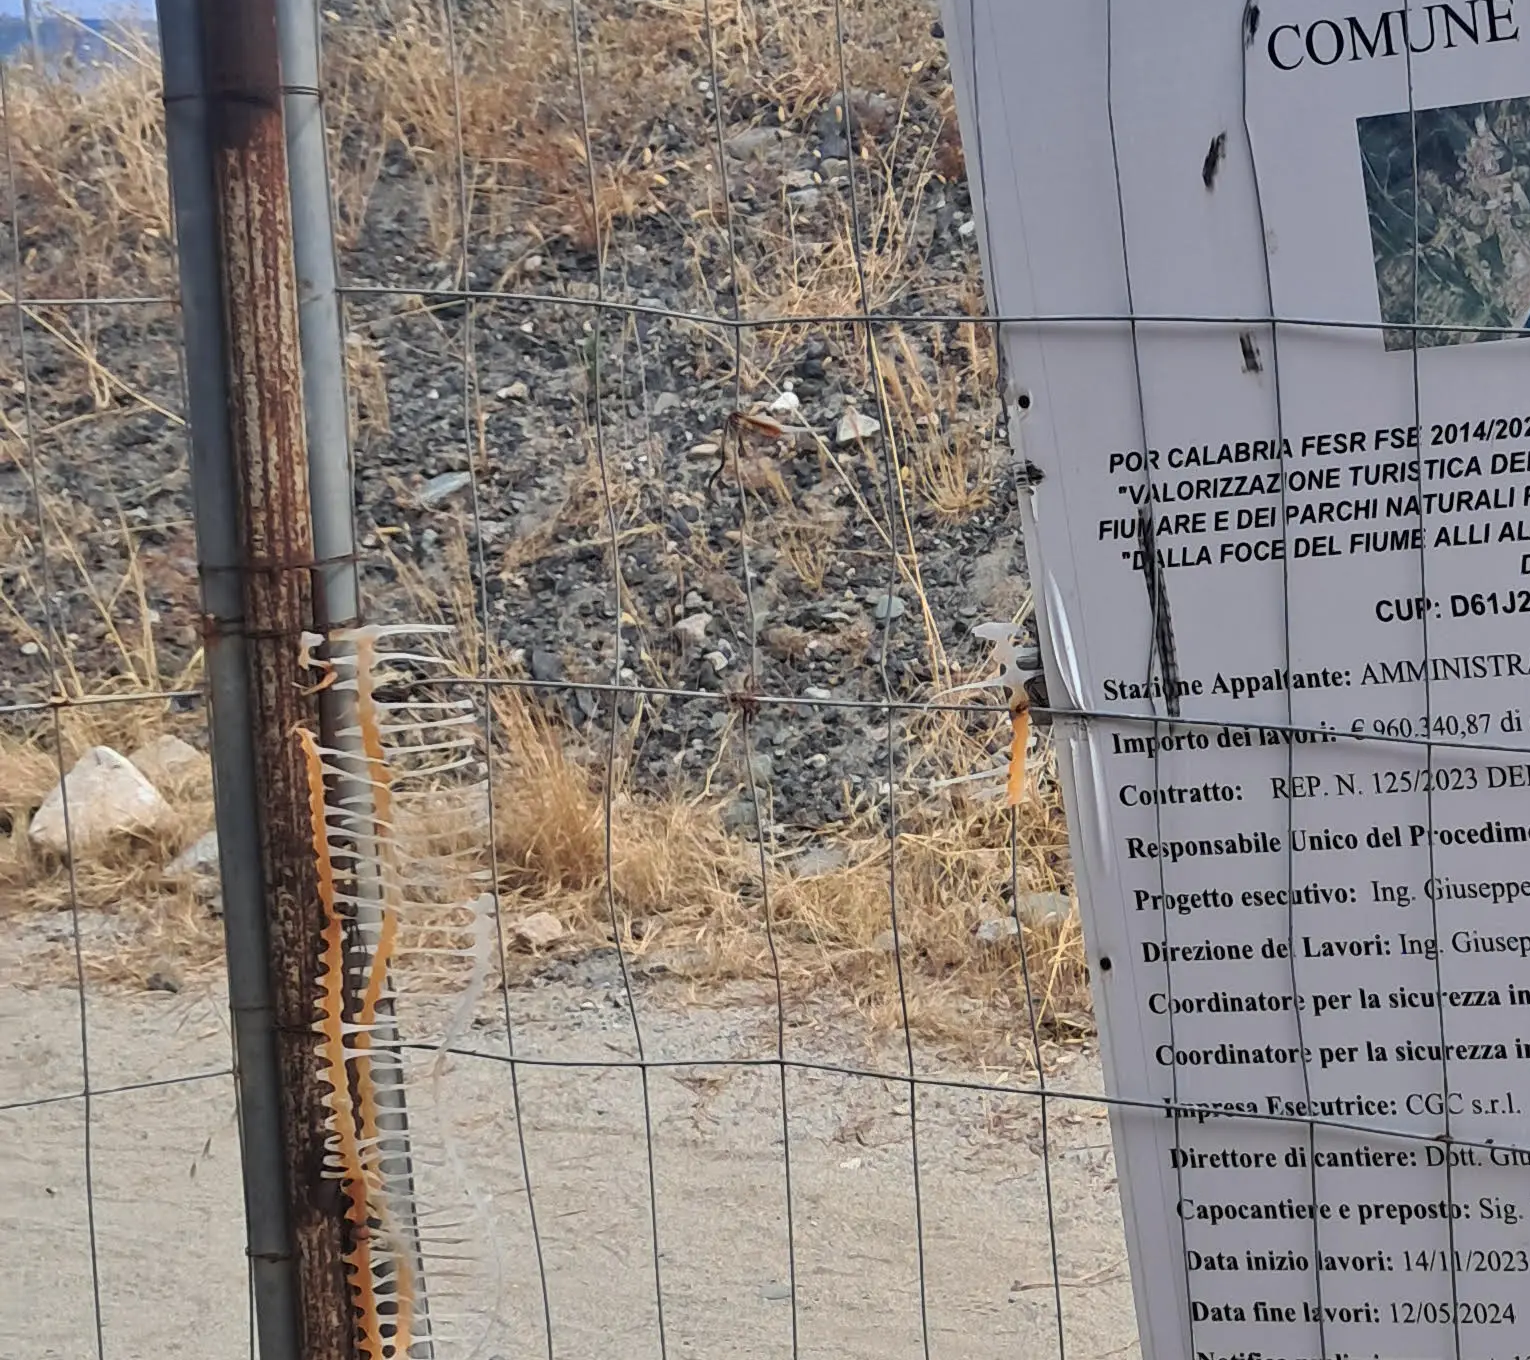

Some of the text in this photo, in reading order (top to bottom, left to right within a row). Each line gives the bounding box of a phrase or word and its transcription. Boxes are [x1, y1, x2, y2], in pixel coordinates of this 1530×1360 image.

[1109, 450, 1158, 473] POR
[1167, 439, 1293, 468] CALABRIA
[1302, 432, 1366, 456] FESR
[1375, 426, 1424, 450] FSE
[1349, 455, 1482, 487] TURISTICA
[1099, 511, 1206, 540] FIUMARE
[1214, 510, 1229, 532] E
[1237, 507, 1276, 530] DEI
[1285, 497, 1377, 526] PARCHI
[1385, 487, 1515, 517] NATURALI
[1220, 540, 1285, 563] FOCE
[1294, 536, 1341, 559] DEL
[1349, 529, 1426, 554] FIUME
[1434, 522, 1490, 548] ALLI
[1375, 596, 1442, 623] CUP:
[1104, 676, 1203, 701] Stazine
[1211, 667, 1351, 698] Appaltante:
[1113, 731, 1209, 758] Importo
[1217, 726, 1251, 748] dei
[1372, 714, 1491, 739] 960.340,87
[1501, 709, 1522, 733] di
[1120, 782, 1243, 807] Contratto:
[1271, 775, 1329, 800] REP.
[1335, 773, 1362, 796] N.
[1372, 767, 1479, 795] 125/2023
[1126, 832, 1281, 862] Responsabile
[1288, 828, 1358, 852] Unico
[1366, 825, 1401, 848] del
[1133, 888, 1233, 915] Progetto
[1241, 883, 1357, 908] esecutivo:
[1371, 880, 1416, 908] Ing.
[1141, 939, 1253, 963] Direzione
[1261, 937, 1296, 959] de
[1303, 933, 1391, 959] Lavori:
[1399, 933, 1444, 960] Ing.
[1149, 992, 1305, 1015] Coordinatore
[1312, 990, 1351, 1017] per
[1359, 987, 1381, 1009] la
[1388, 986, 1501, 1009] sicurezza
[1155, 1043, 1312, 1067] Coordinatore
[1319, 1043, 1358, 1068] per
[1366, 1040, 1388, 1062] la
[1395, 1040, 1508, 1062] sicurezza
[1265, 1094, 1397, 1118] Esecutrice:
[1405, 1092, 1464, 1116] CGC
[1472, 1091, 1521, 1115] s.r.l.
[1169, 1146, 1277, 1169] Direttore
[1284, 1146, 1307, 1168] di
[1313, 1146, 1417, 1169] cantiere:
[1425, 1145, 1482, 1168] Dott.
[1176, 1198, 1331, 1225] Capocantiere
[1338, 1205, 1351, 1220] e
[1358, 1201, 1470, 1225] preposto:
[1478, 1197, 1524, 1225] Sig.
[1185, 1249, 1530, 1273] Data inizio lavori: 14/11/2023
[1191, 1300, 1245, 1323] Data
[1252, 1301, 1296, 1323] fine
[1303, 1301, 1380, 1324] lavori:
